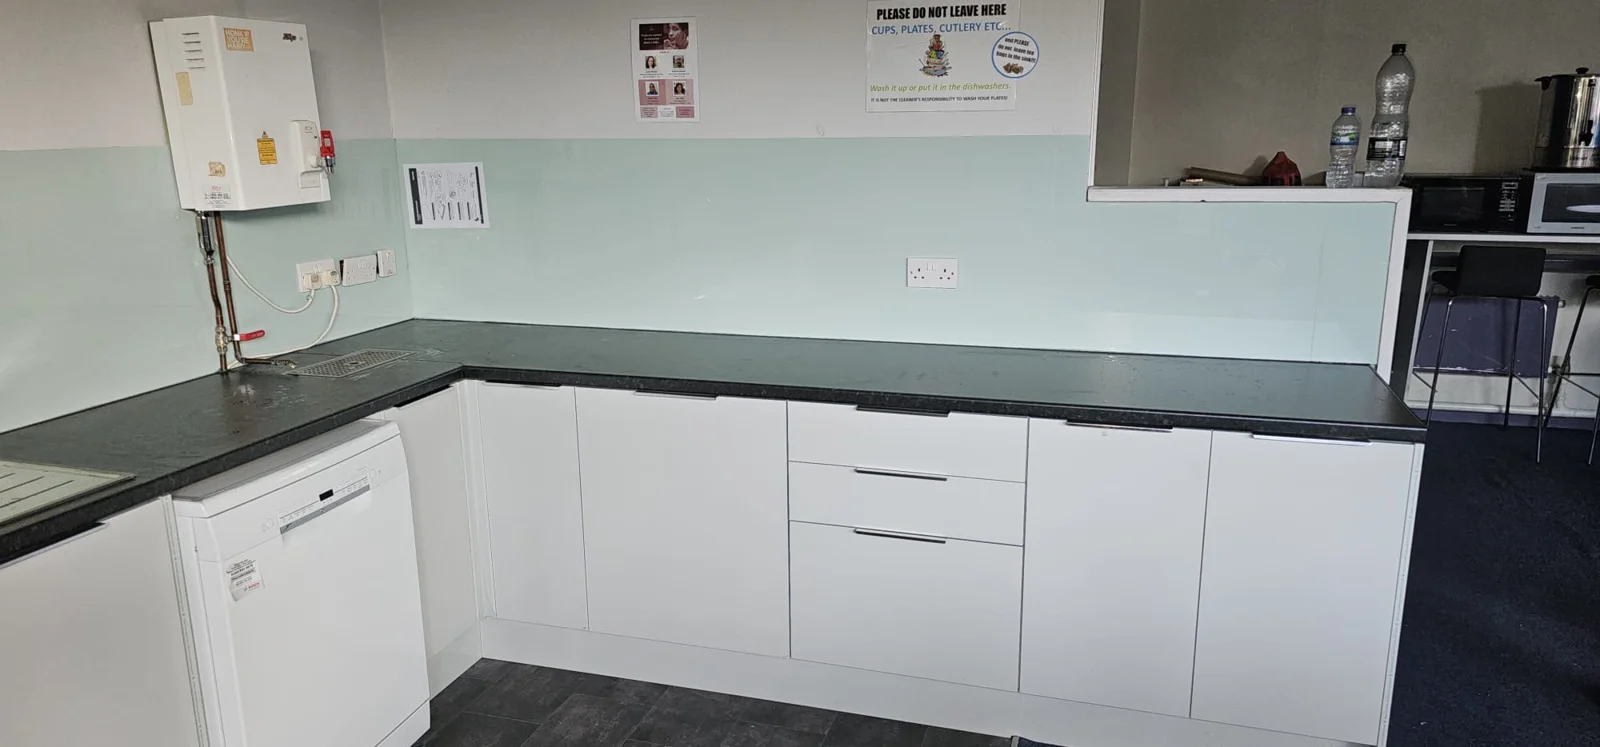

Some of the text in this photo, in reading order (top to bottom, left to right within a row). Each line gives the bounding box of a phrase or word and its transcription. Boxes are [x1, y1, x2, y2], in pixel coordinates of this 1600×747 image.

[877, 4, 1006, 20] PLEASE DO NOT LEAVE HERE
[872, 21, 1011, 35] CUPS, PLATES, CUTLERY ETC...
[1014, 38, 1029, 46] PLEASE
[870, 84, 889, 92] Wash
[898, 85, 907, 93] up
[918, 84, 931, 92] put
[962, 82, 1011, 90] dishwashers.
